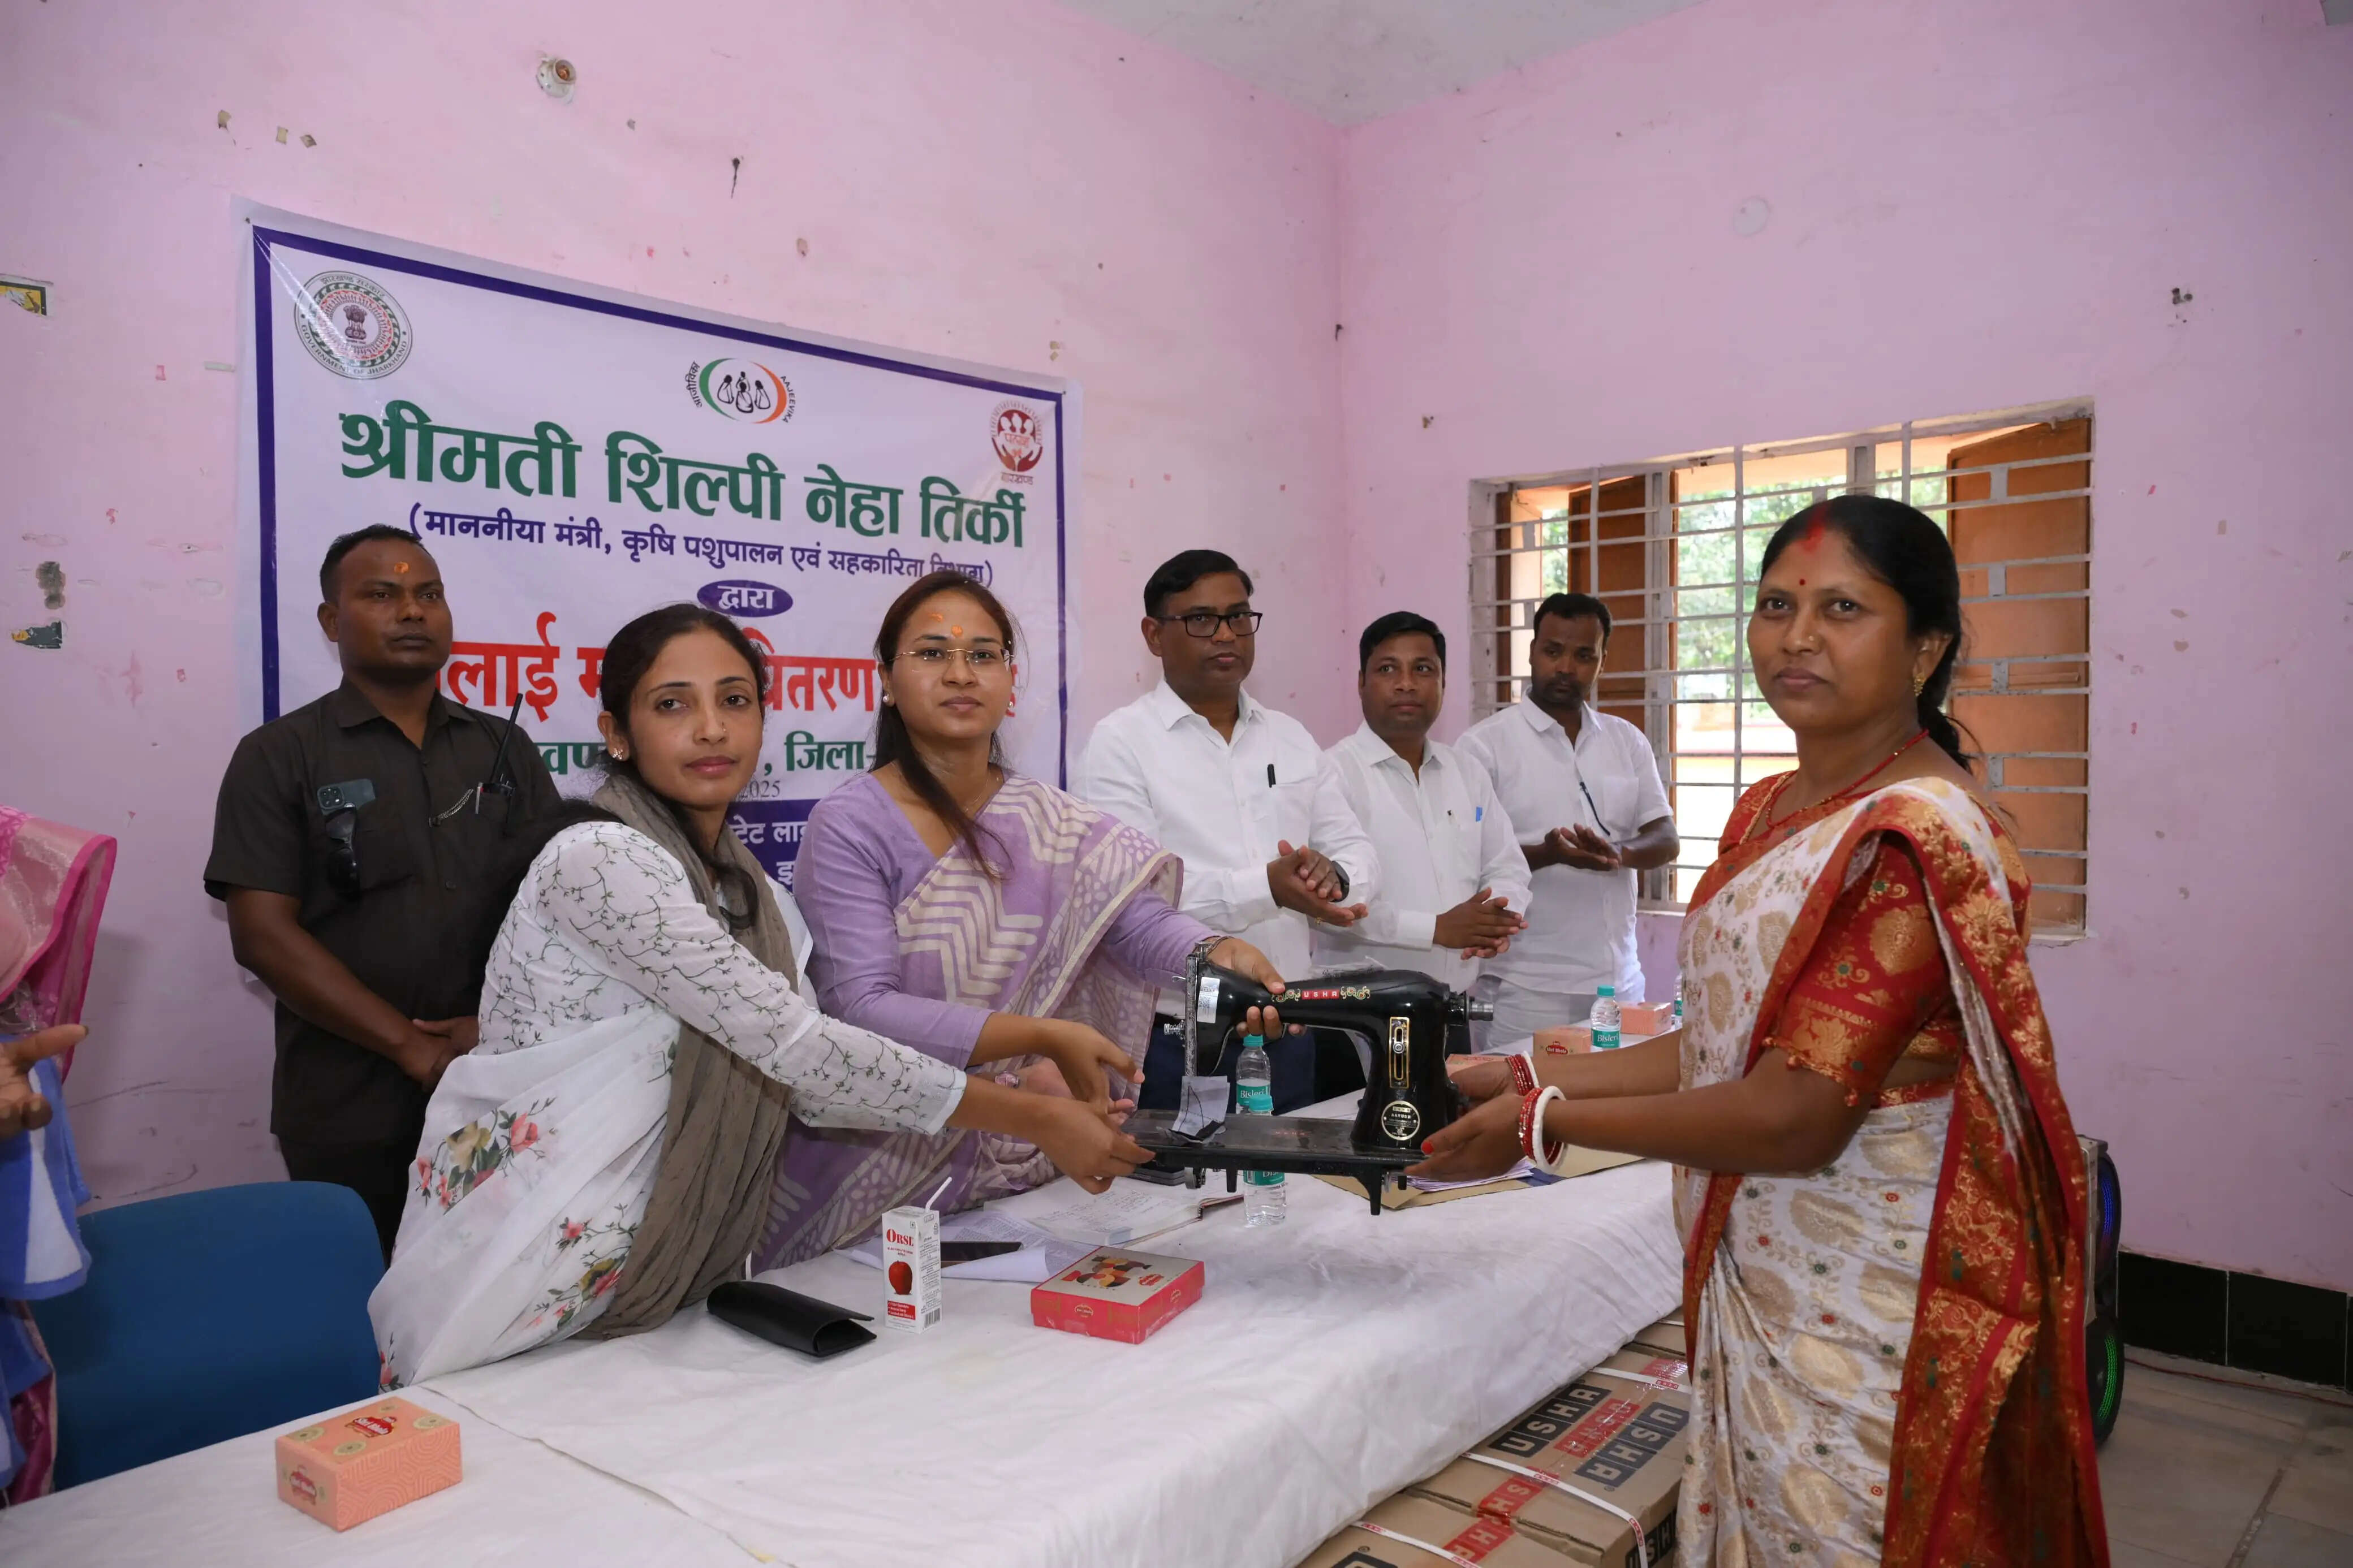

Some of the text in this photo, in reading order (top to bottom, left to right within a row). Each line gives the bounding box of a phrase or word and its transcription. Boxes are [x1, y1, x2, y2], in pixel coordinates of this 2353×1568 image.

[301, 324, 350, 373] GOVERNMENT
[368, 340, 407, 375] JHARKHAND
[684, 360, 703, 409] आजीविका
[780, 375, 796, 424] AAJEEVIKA
[339, 400, 1027, 548] श्रीमती शिल्पी नेहा तिर्की
[410, 502, 546, 543] (माननीया
[554, 516, 611, 555] मंत्री,
[622, 524, 676, 563] कृषि
[683, 535, 784, 569] पशुपालन
[790, 542, 822, 572] एवं
[828, 548, 925, 578] सहकारिता
[717, 585, 775, 610] द्वारा
[1597, 1033, 1619, 1043] Bisleri
[1501, 1387, 1601, 1452] USHA
[1585, 1408, 1683, 1481] USHA
